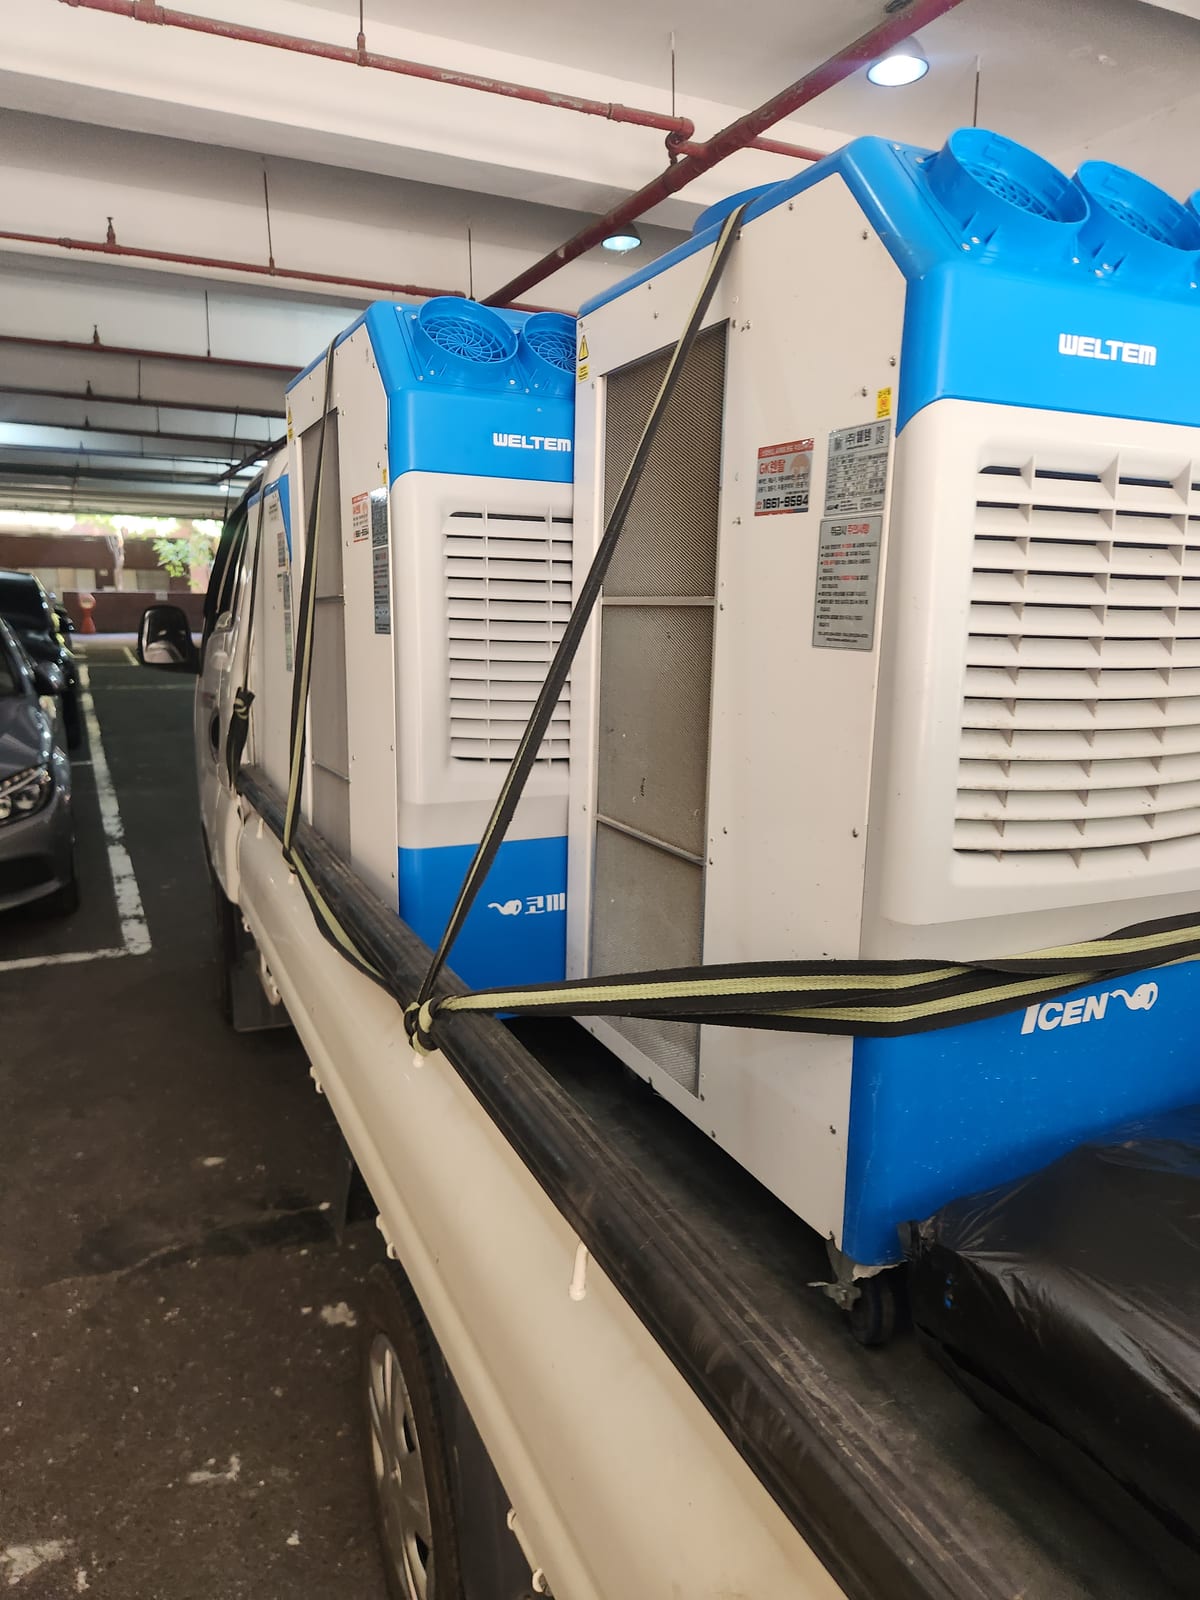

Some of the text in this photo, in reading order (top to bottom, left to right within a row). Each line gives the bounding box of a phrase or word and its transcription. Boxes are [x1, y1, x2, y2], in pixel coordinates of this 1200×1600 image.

[1058, 333, 1157, 366] WELTEM
[493, 432, 572, 452] WELTEM
[762, 494, 809, 509] 1661-9594
[1020, 992, 1110, 1035] ICEN
